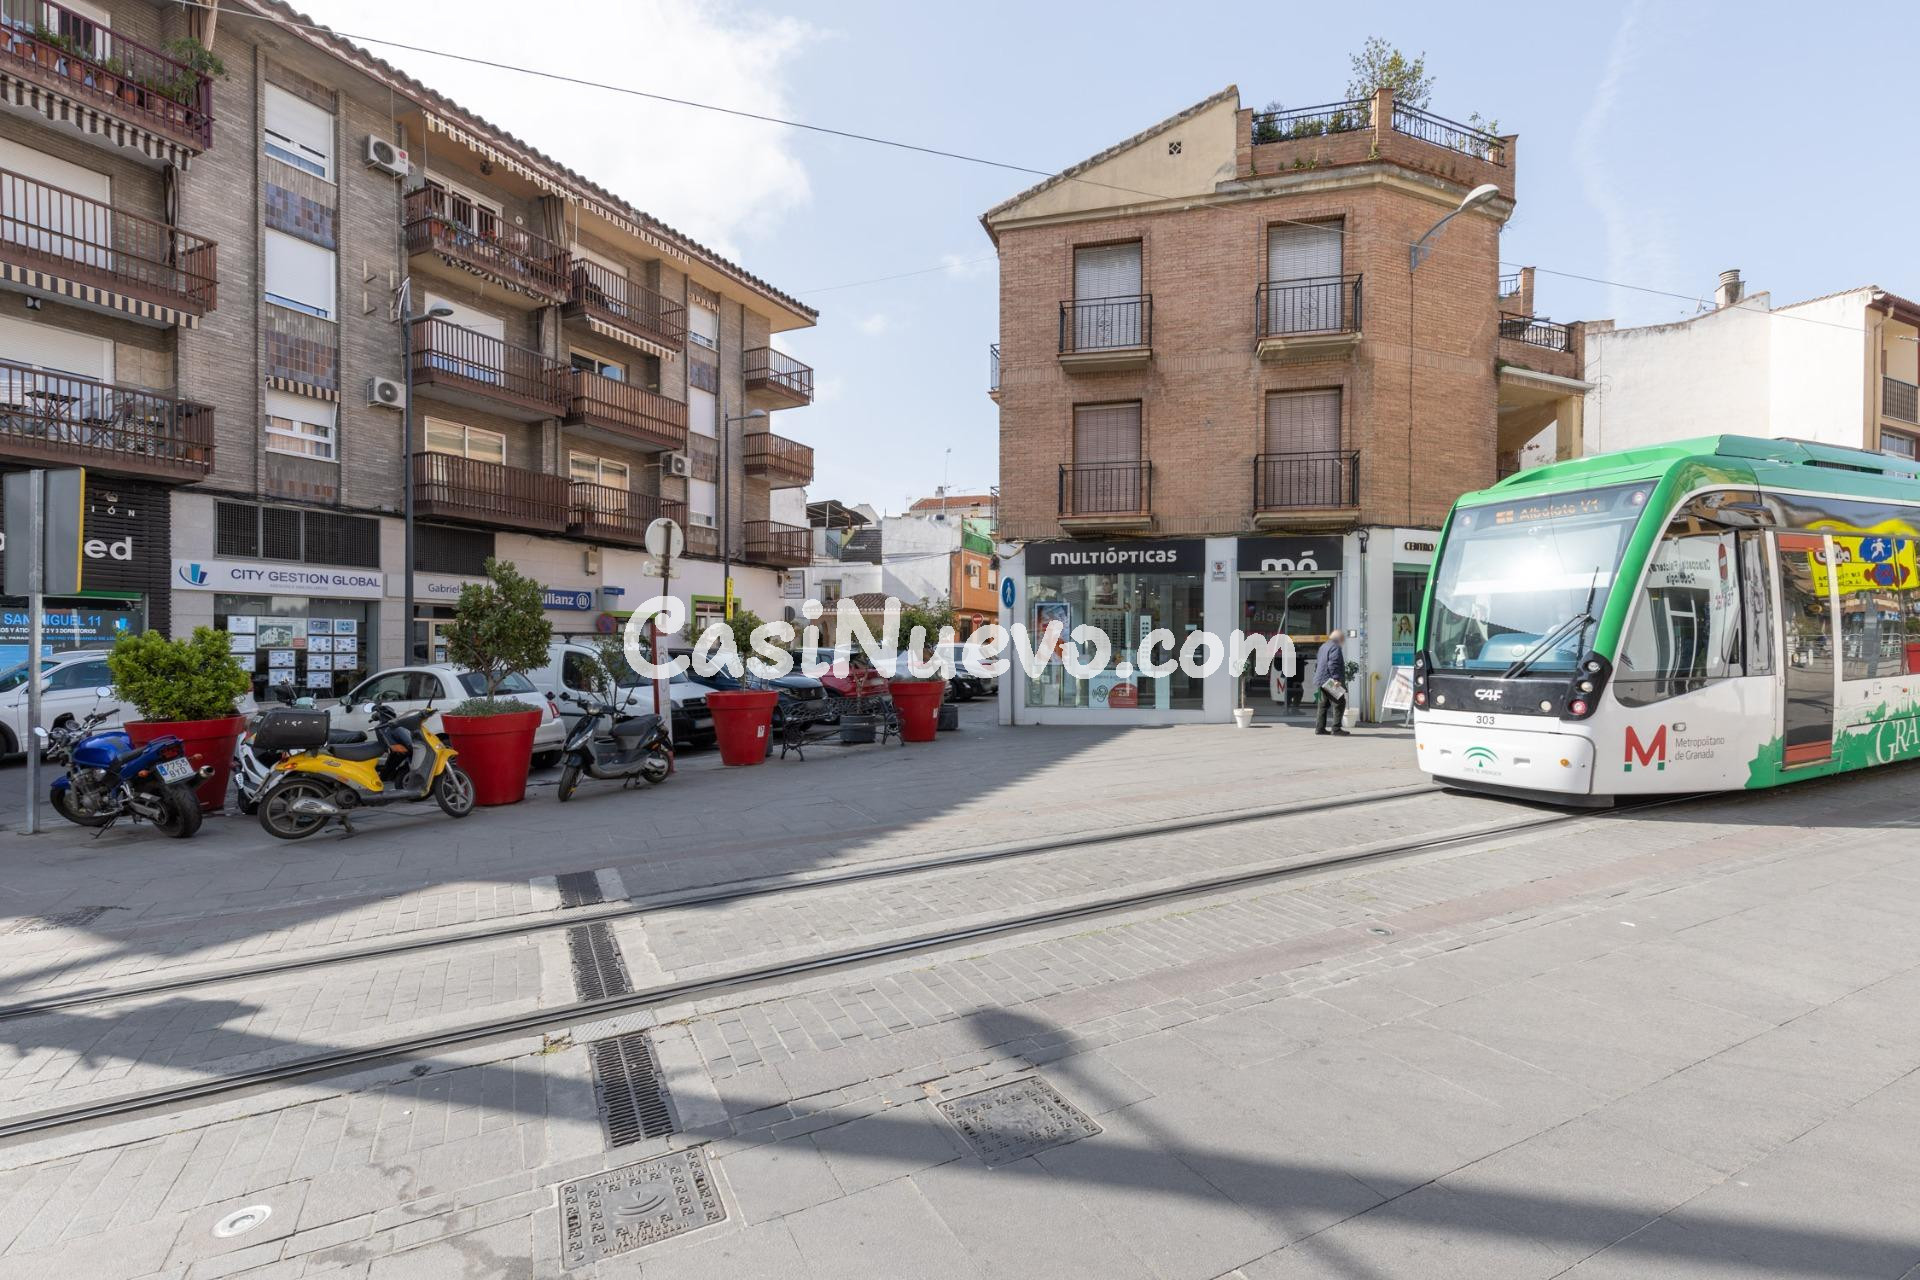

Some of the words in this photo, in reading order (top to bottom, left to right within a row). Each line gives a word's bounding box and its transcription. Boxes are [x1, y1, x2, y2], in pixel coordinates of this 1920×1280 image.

[1520, 504, 1576, 520] Albolote
[1404, 541, 1434, 552] CENTRO
[231, 568, 265, 580] CITY
[268, 571, 329, 584] GESTION
[332, 575, 381, 588] GLOBAL
[428, 583, 460, 594] Gabriel
[88, 616, 101, 627] 11
[1474, 688, 1504, 701] CAF
[1476, 715, 1495, 725] 303
[1675, 736, 1725, 748] Metropolitano
[1875, 712, 1920, 764] GRA
[1674, 752, 1685, 761] de
[1685, 749, 1714, 760] Granada
